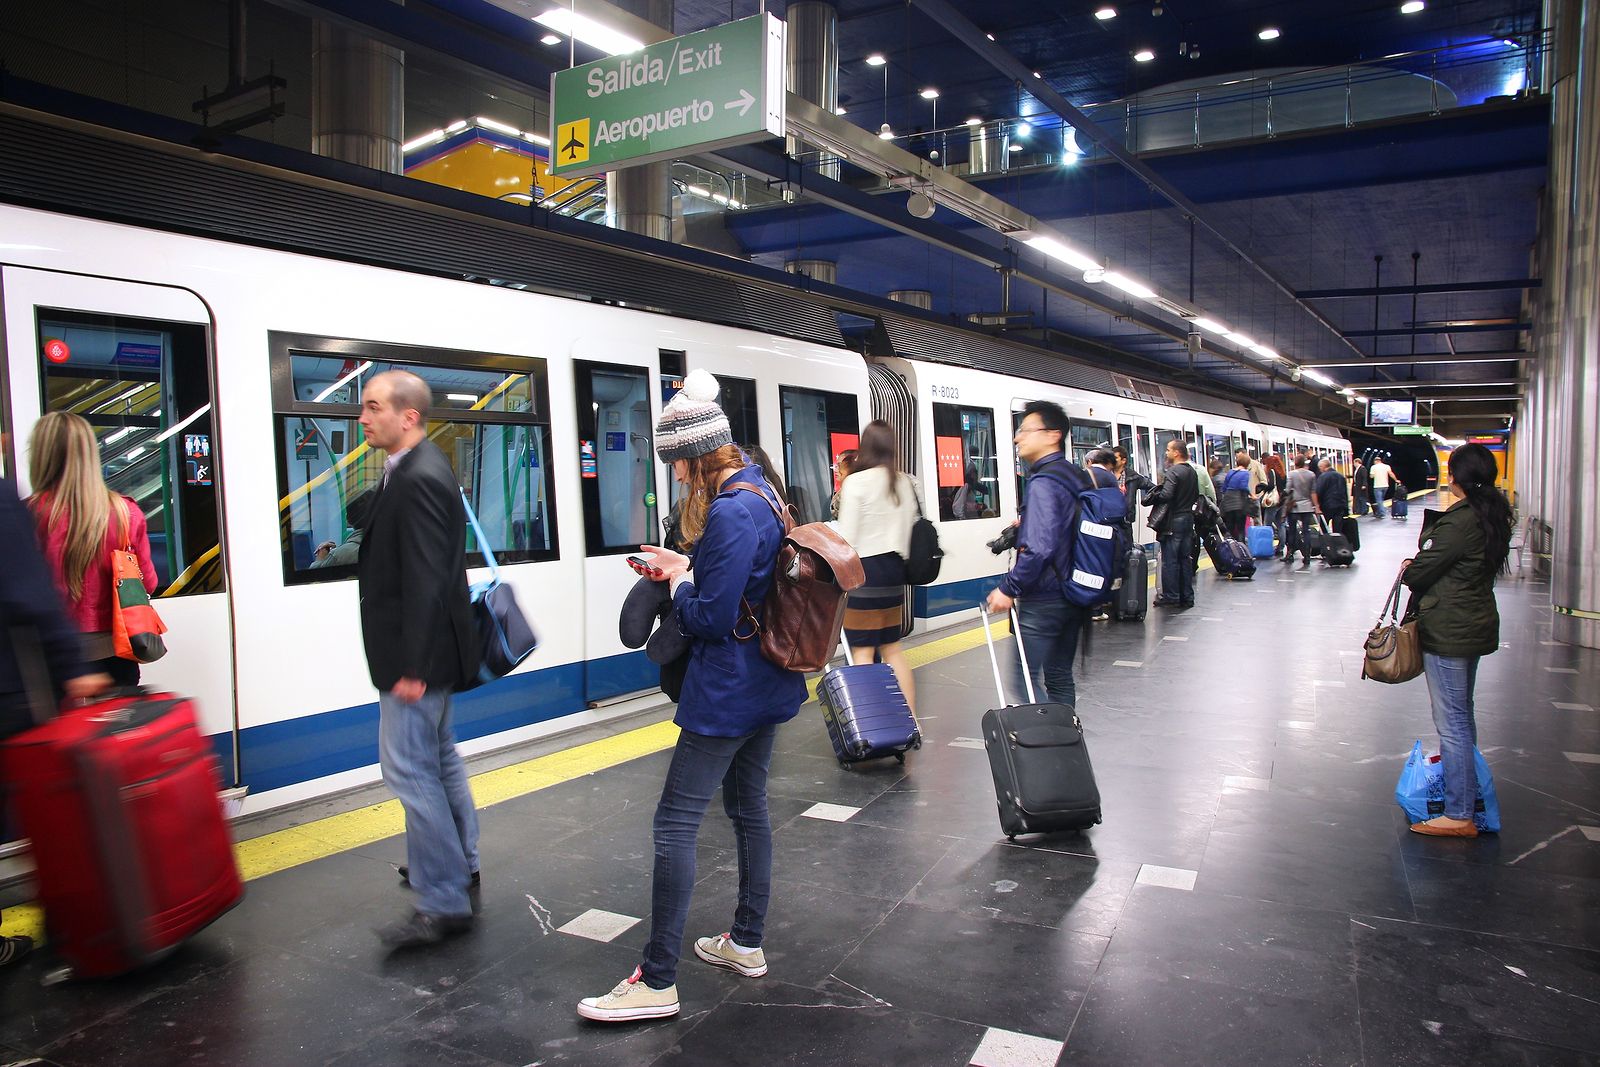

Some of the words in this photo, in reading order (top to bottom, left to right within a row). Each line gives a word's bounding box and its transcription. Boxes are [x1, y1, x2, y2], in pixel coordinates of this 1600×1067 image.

[587, 41, 722, 98] Salida/Exit
[594, 98, 713, 147] Aeropuerto
[932, 384, 960, 399] R-8023
